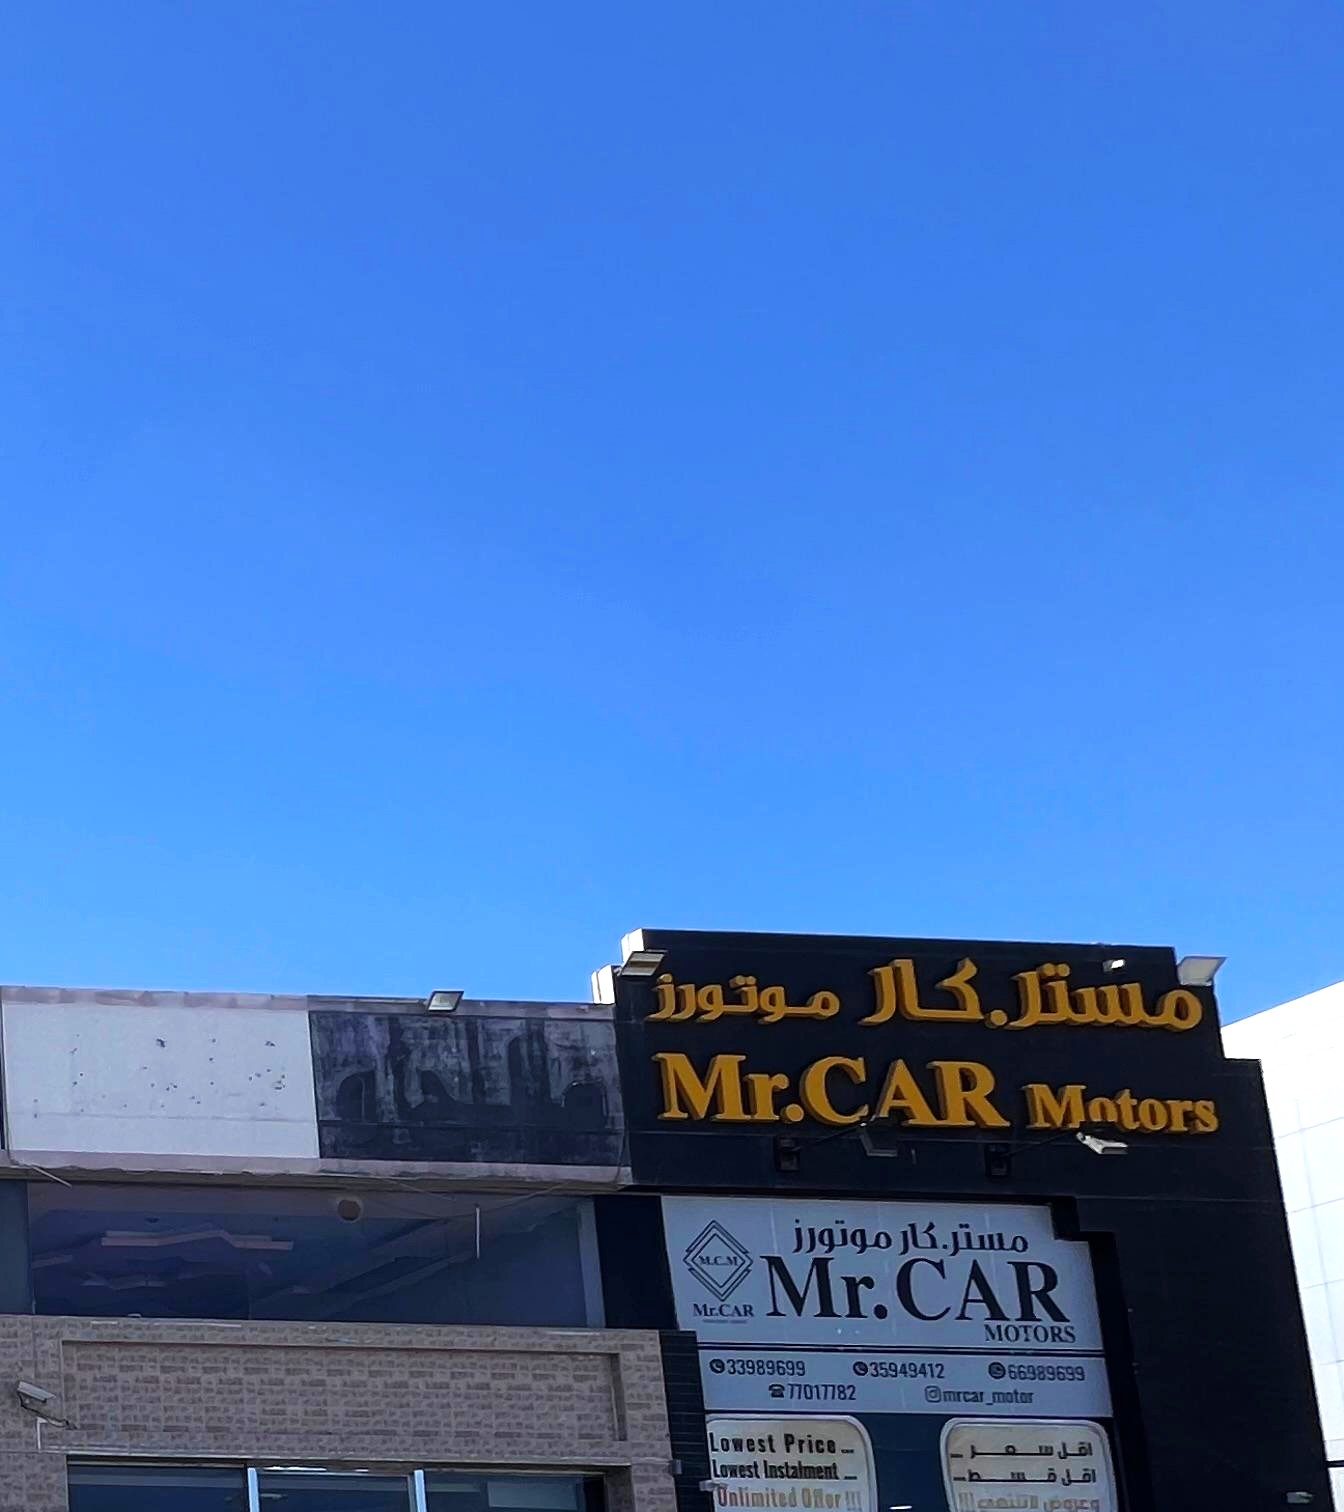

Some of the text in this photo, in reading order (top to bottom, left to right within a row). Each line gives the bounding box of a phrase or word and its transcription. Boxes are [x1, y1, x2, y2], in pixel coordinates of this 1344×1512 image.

[647, 973, 840, 1024] موتورز
[653, 1051, 1220, 1135] Mr.CAR Motors
[792, 1219, 892, 1254] موتورز
[760, 1254, 1071, 1322] Mr.CAR
[693, 1303, 754, 1318] Mr.CAR
[984, 1323, 1077, 1344] MOTORS
[726, 1358, 806, 1376] 33989699
[869, 1362, 945, 1379] 35949412
[787, 1383, 856, 1400] 77017782
[709, 1432, 836, 1454] Lowest Price
[1057, 1441, 1093, 1459] اقل
[712, 1459, 840, 1480] Lowest Instalment
[1061, 1468, 1097, 1486] اقل
[717, 1486, 797, 1507] Unlimited
[801, 1487, 841, 1509] Offer
